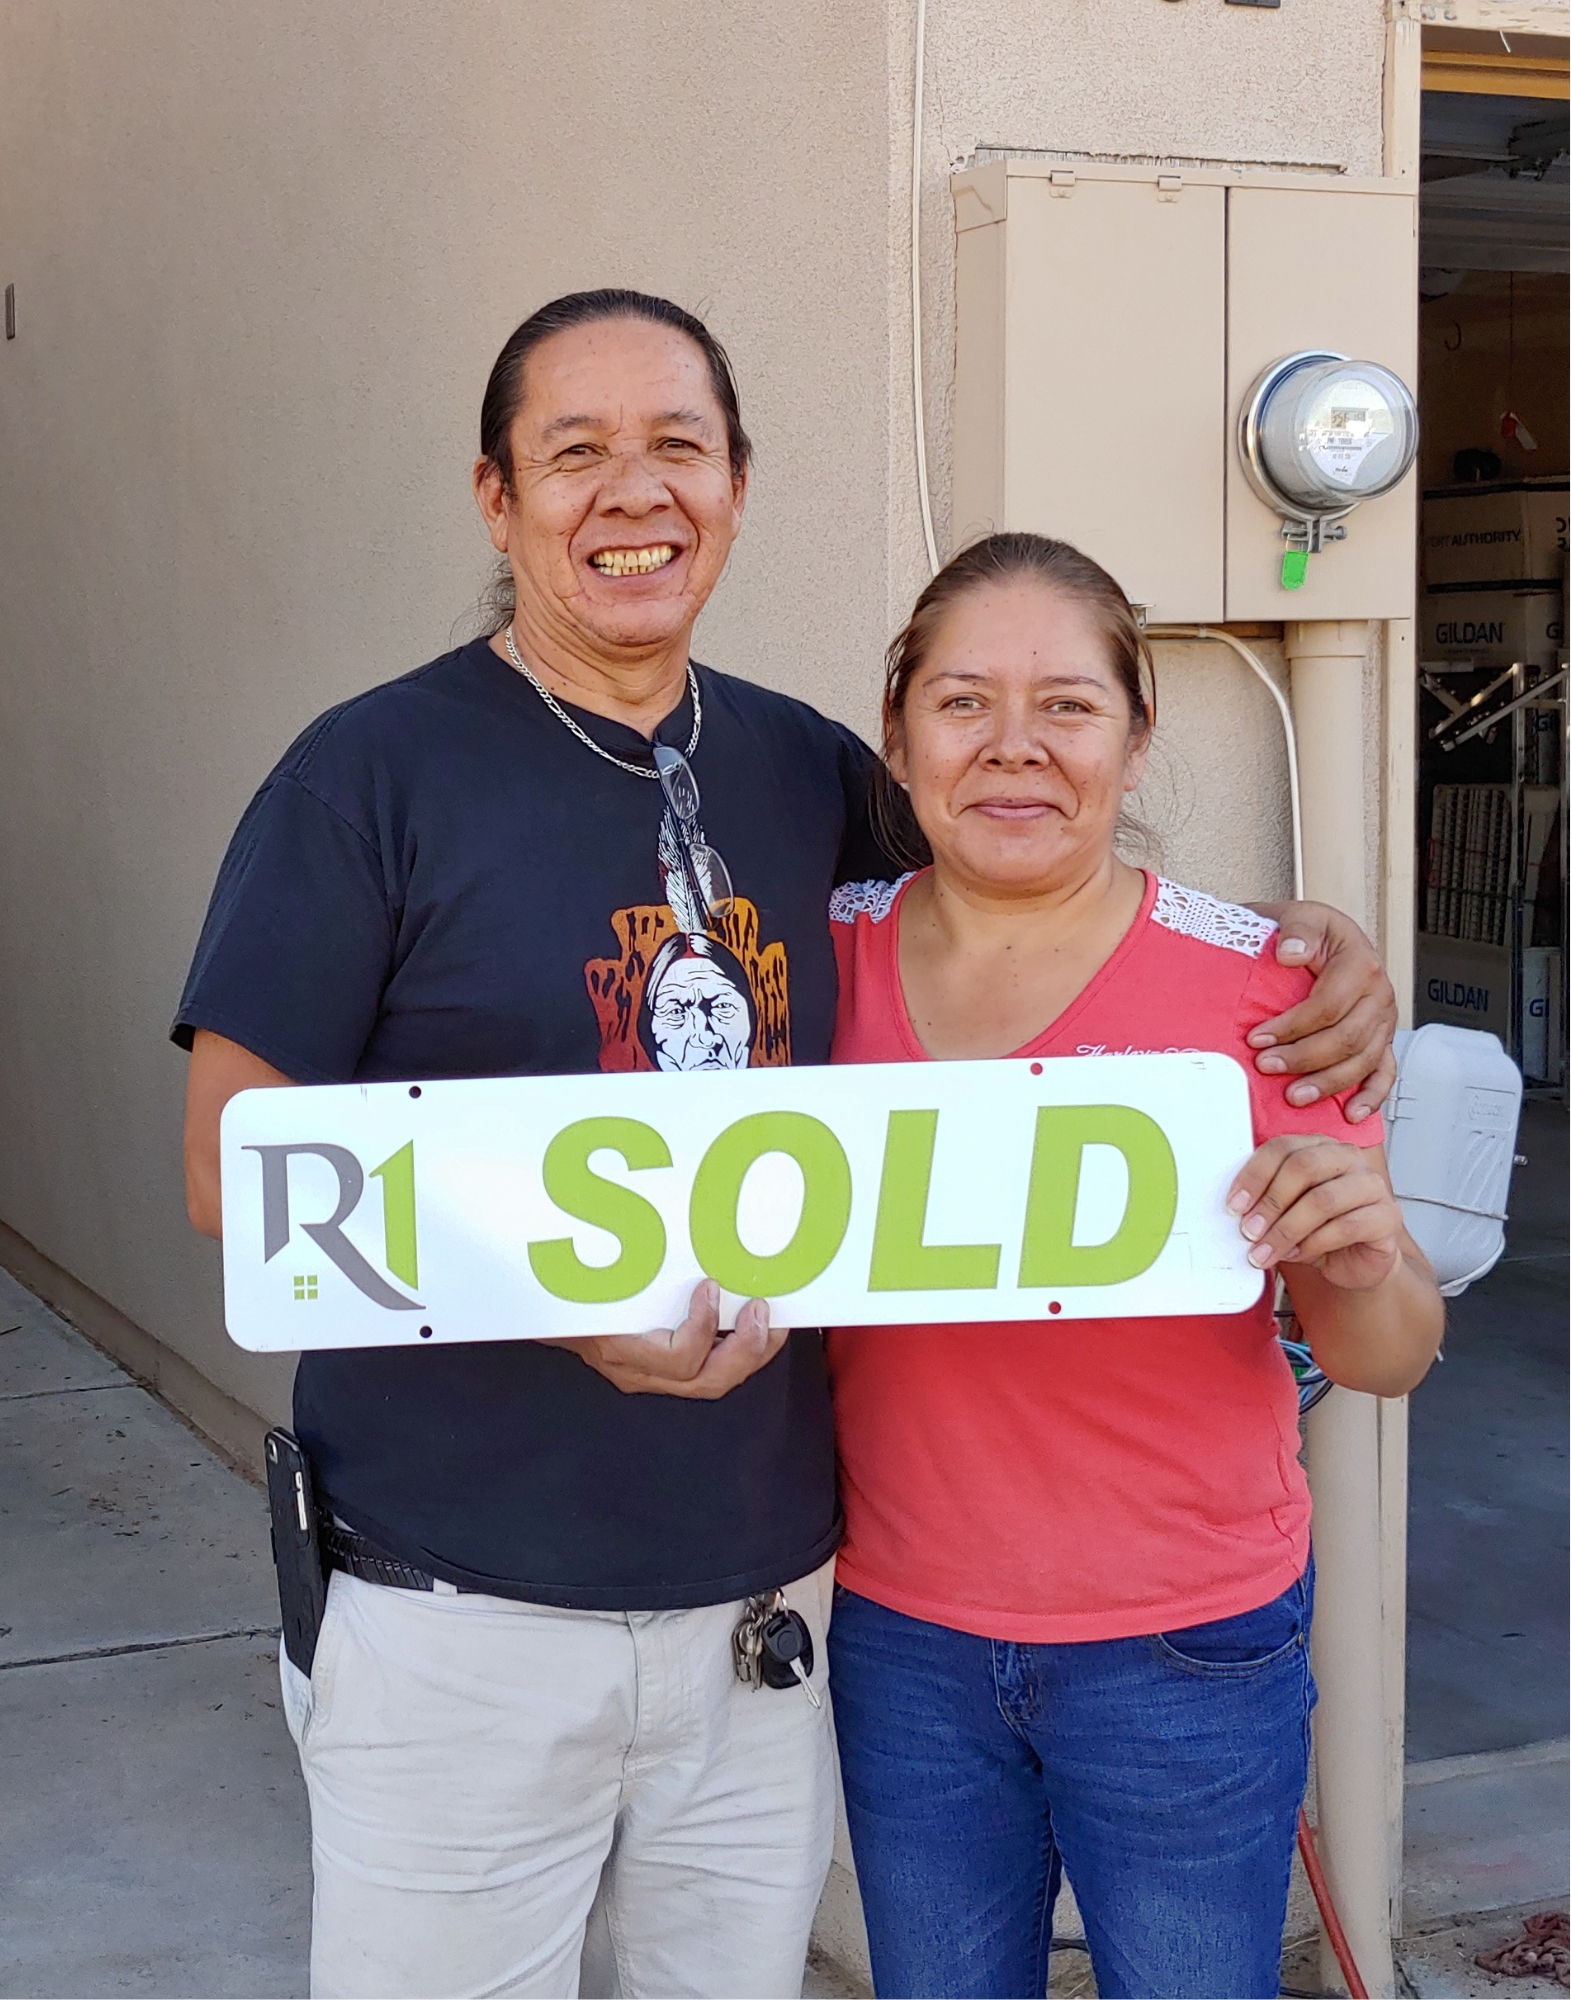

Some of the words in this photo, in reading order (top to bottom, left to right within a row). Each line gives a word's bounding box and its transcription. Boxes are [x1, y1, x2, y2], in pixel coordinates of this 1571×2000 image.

[1451, 528, 1521, 547] AUTHORITY
[1436, 621, 1503, 645] GILDAN
[1427, 978, 1489, 1013] GILDAN
[527, 1103, 1179, 1304] SOLD
